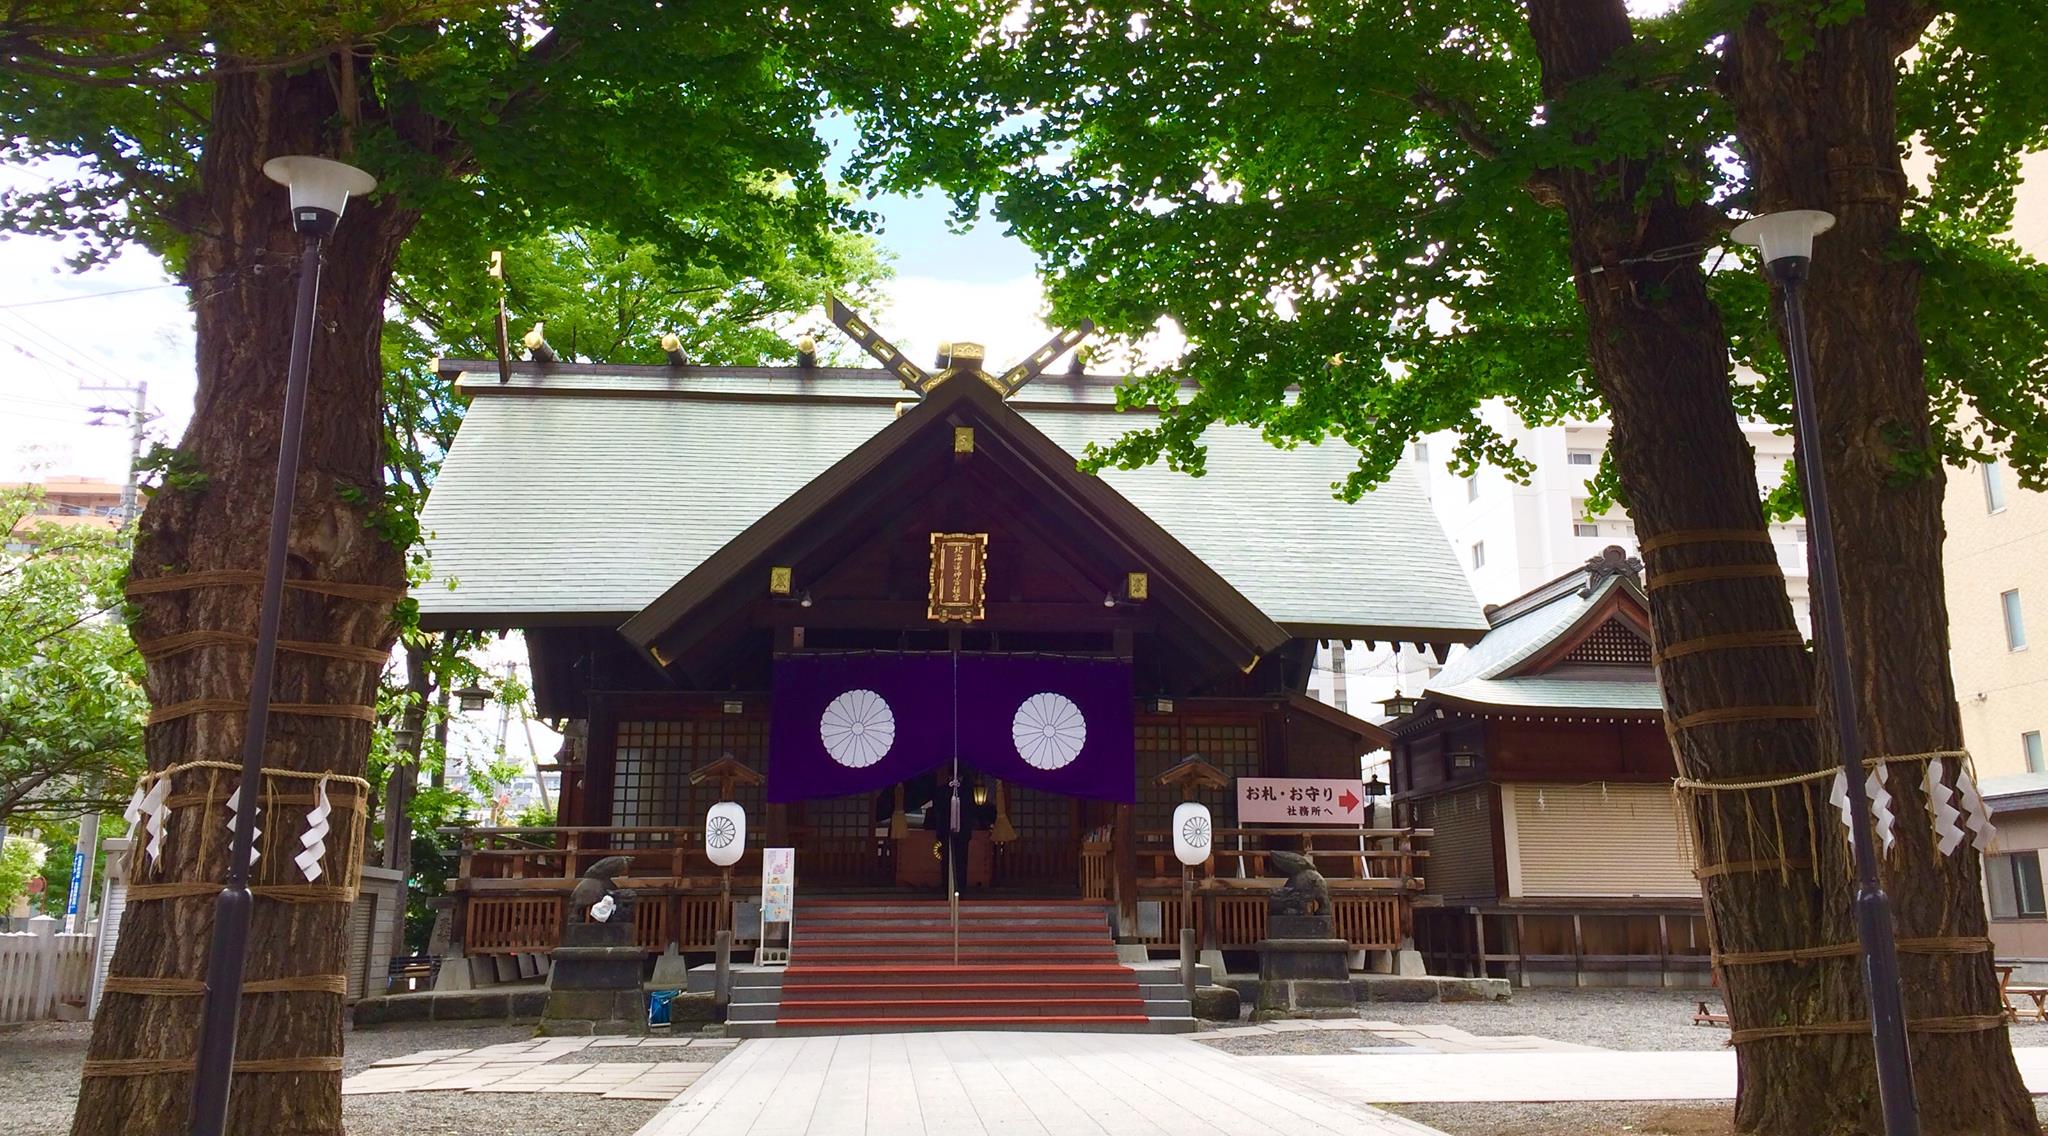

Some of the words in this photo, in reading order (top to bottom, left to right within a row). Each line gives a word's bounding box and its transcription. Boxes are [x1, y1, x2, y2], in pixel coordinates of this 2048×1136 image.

[1246, 786, 1333, 802] お札・お守り
[1287, 806, 1333, 817] 社務所へ
